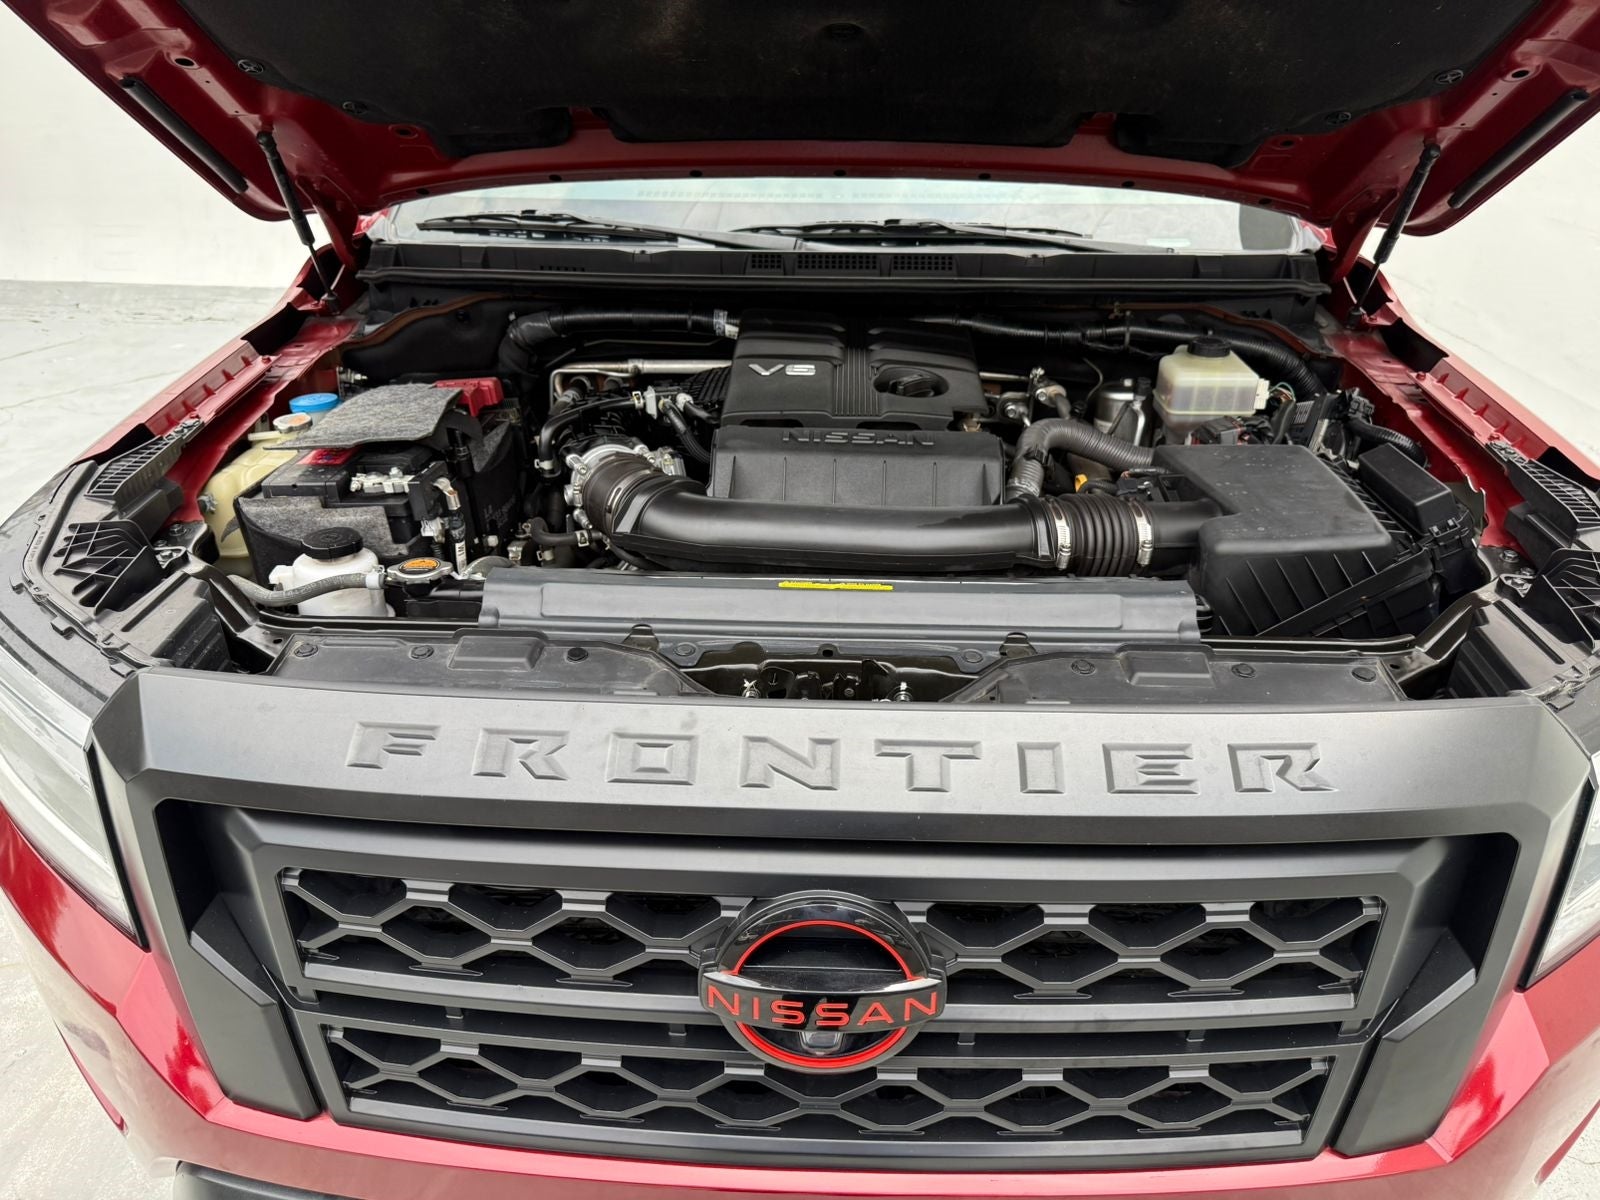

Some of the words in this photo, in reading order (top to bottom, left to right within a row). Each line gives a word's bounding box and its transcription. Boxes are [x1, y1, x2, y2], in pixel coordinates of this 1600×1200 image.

[748, 363, 816, 376] V6
[782, 430, 935, 446] NISSAN
[345, 721, 1339, 795] FRONTIER
[706, 984, 938, 1027] NISSAN
